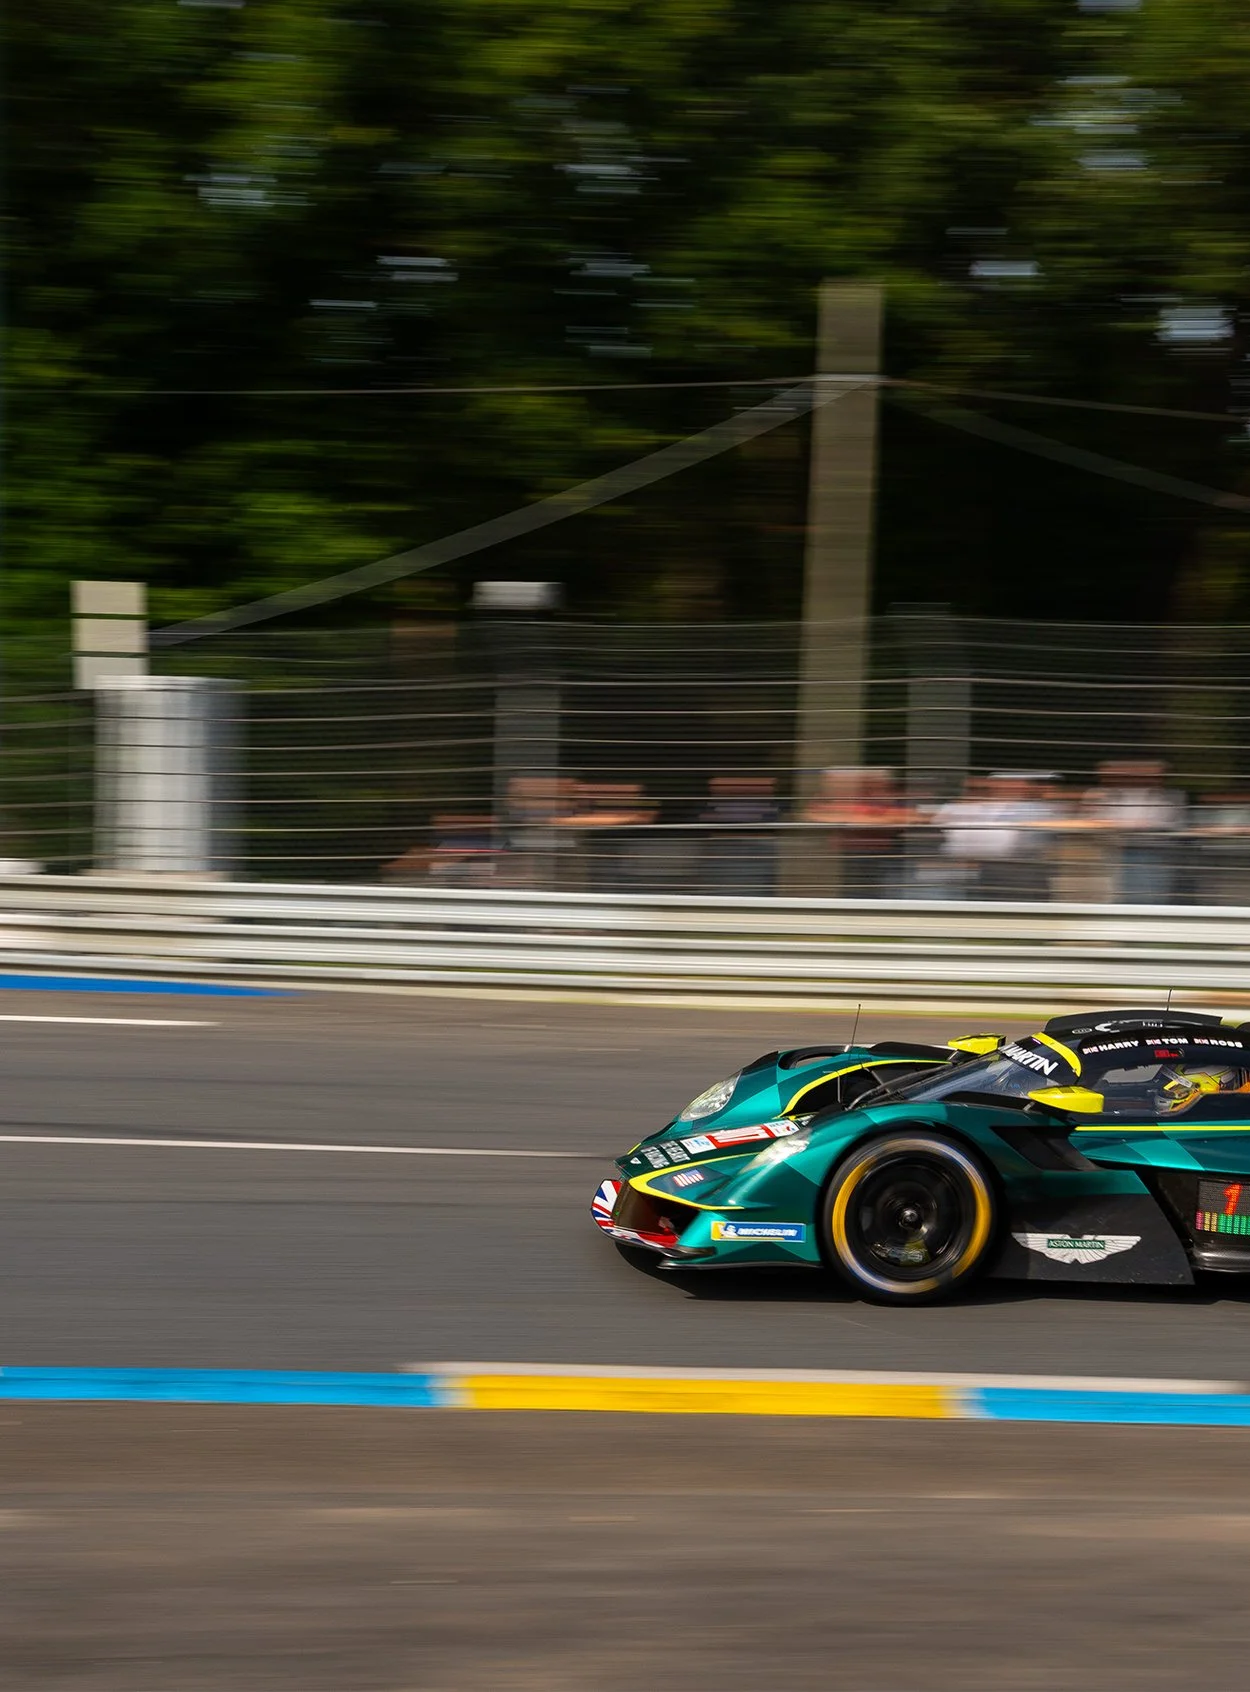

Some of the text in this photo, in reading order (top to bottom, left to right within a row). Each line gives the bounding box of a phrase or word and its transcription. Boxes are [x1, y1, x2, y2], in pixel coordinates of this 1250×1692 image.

[1099, 1040, 1139, 1052] HARRY
[1209, 1039, 1243, 1049] ROSS
[1003, 1044, 1059, 1076] MARTIN
[1223, 1183, 1243, 1215] 1
[737, 1228, 798, 1237] MICHELIN
[1049, 1240, 1105, 1249] ASTON MARTIN
